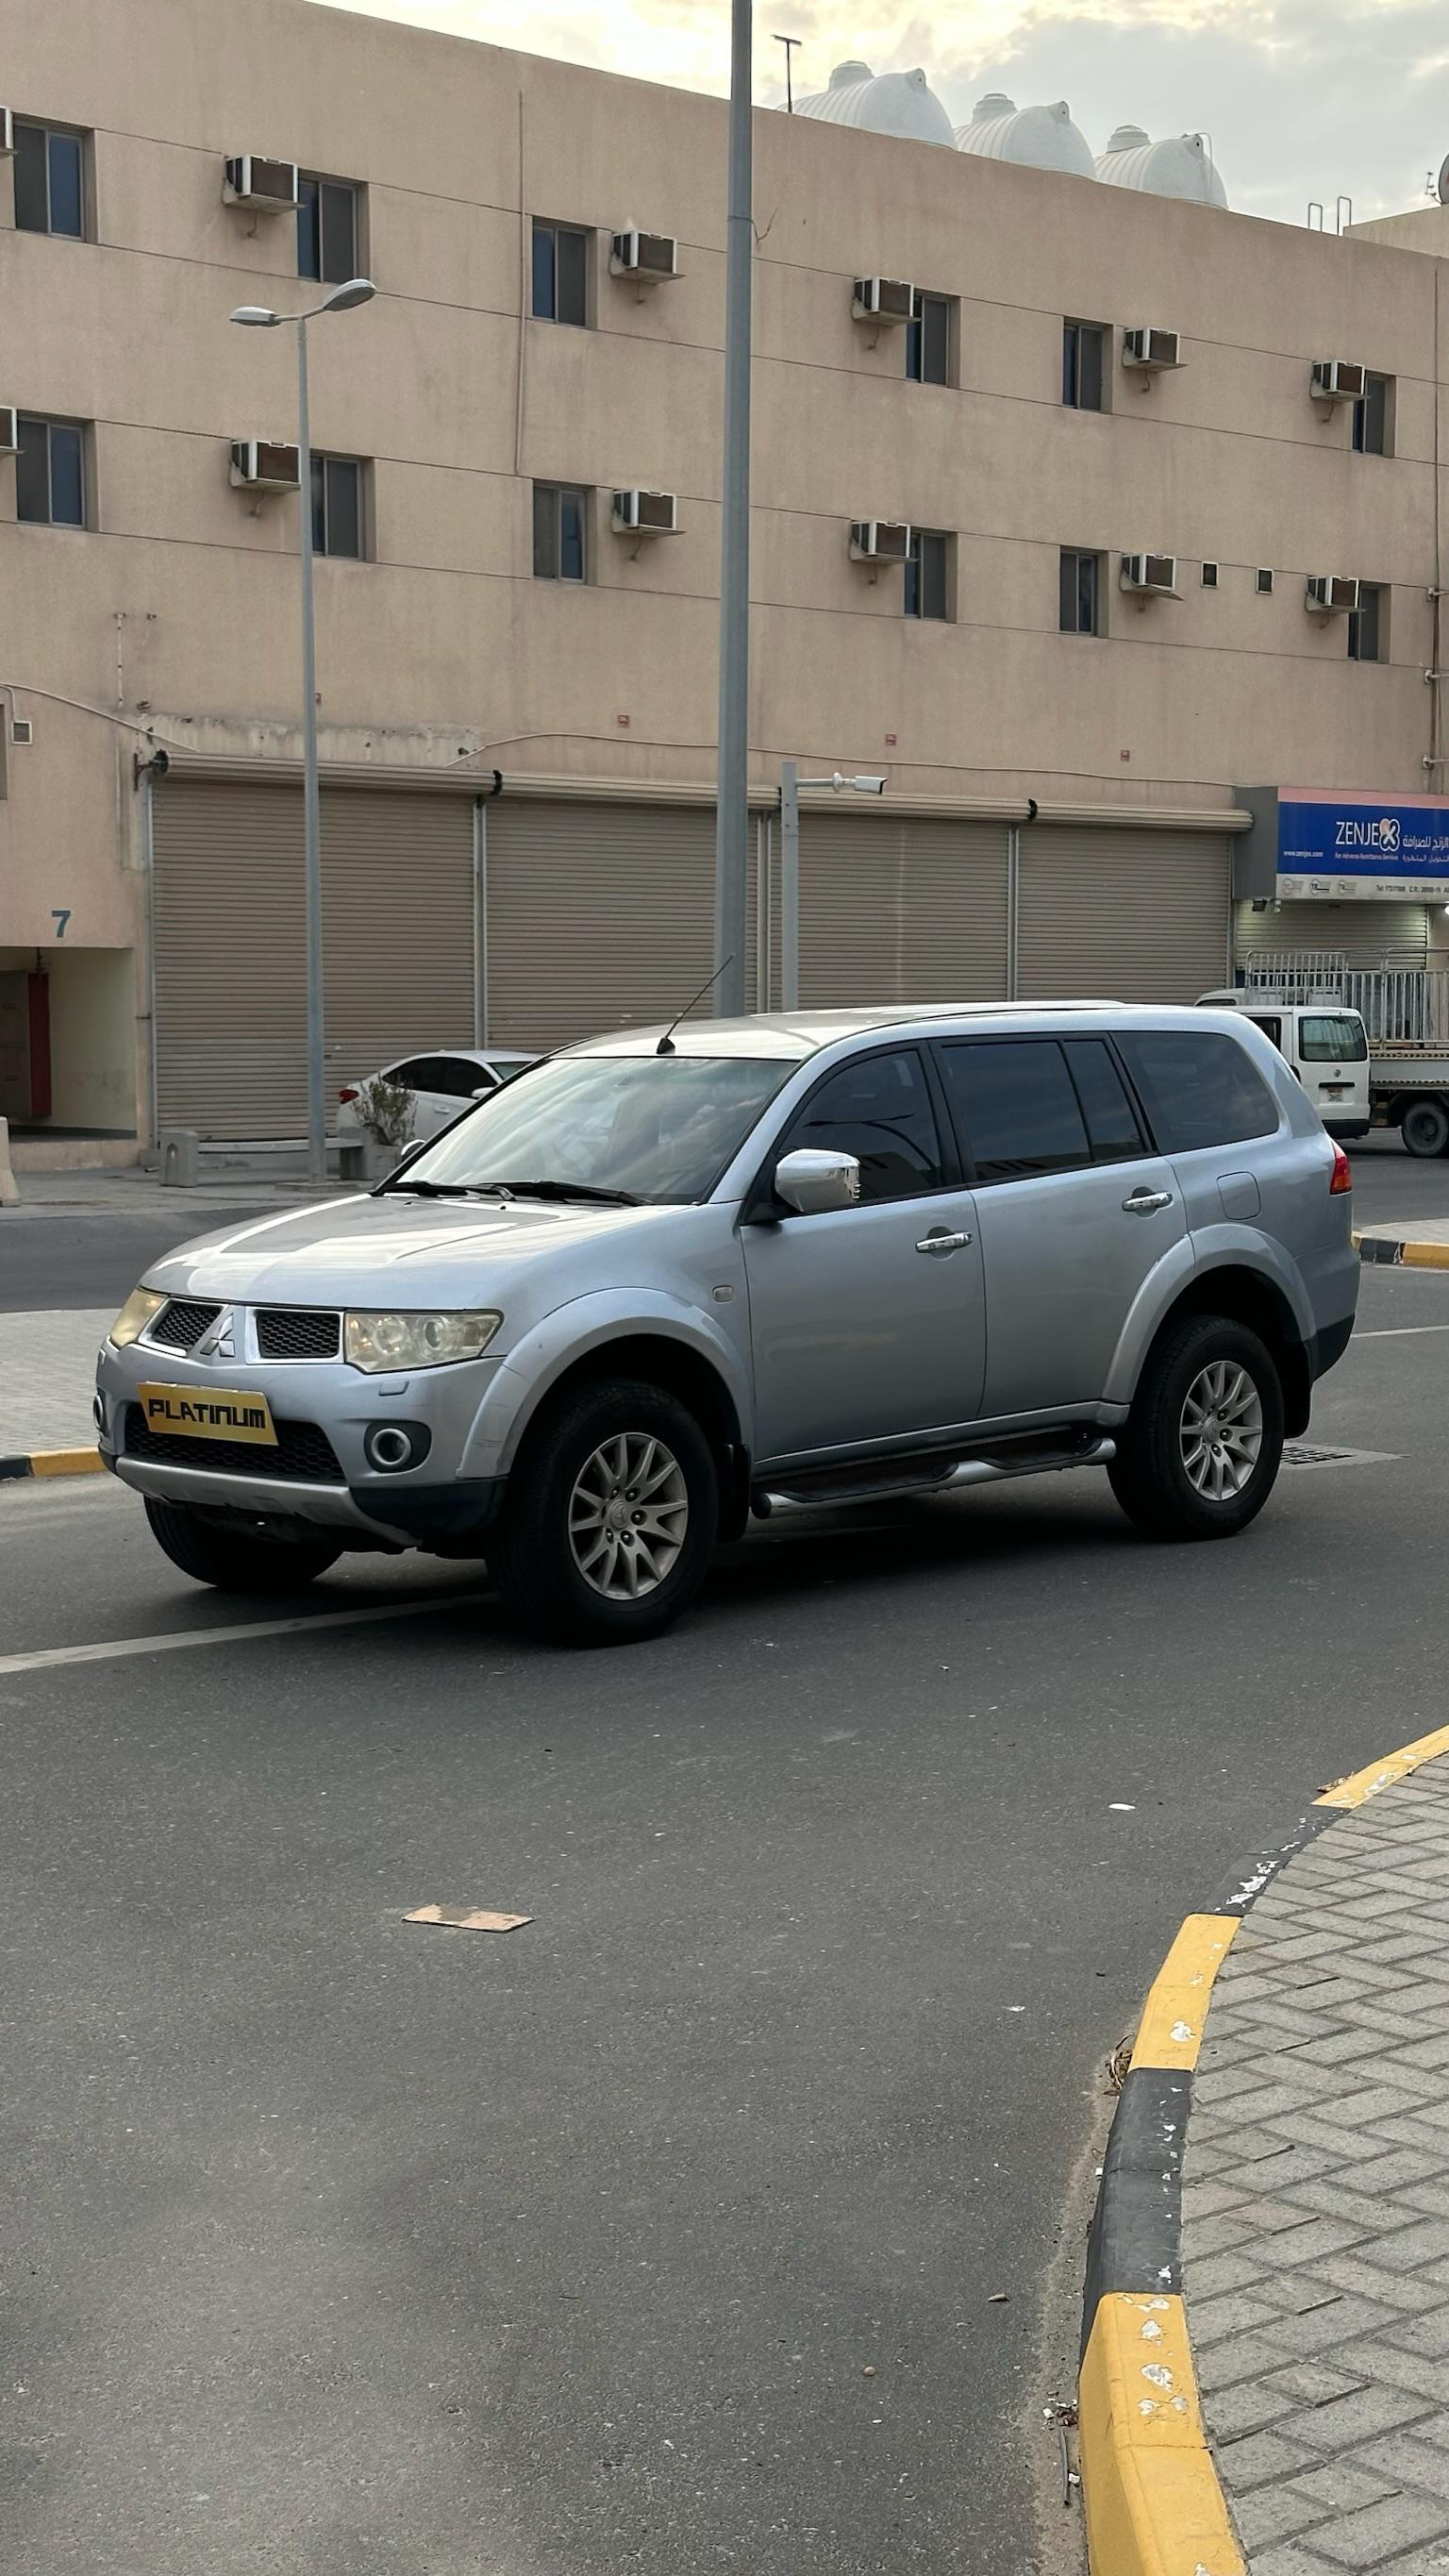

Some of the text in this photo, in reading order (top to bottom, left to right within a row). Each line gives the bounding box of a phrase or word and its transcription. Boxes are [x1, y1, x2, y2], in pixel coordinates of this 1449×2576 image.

[1335, 819, 1400, 850] ZENJEX
[51, 910, 72, 938] 7
[148, 1398, 267, 1429] PLATINUM
